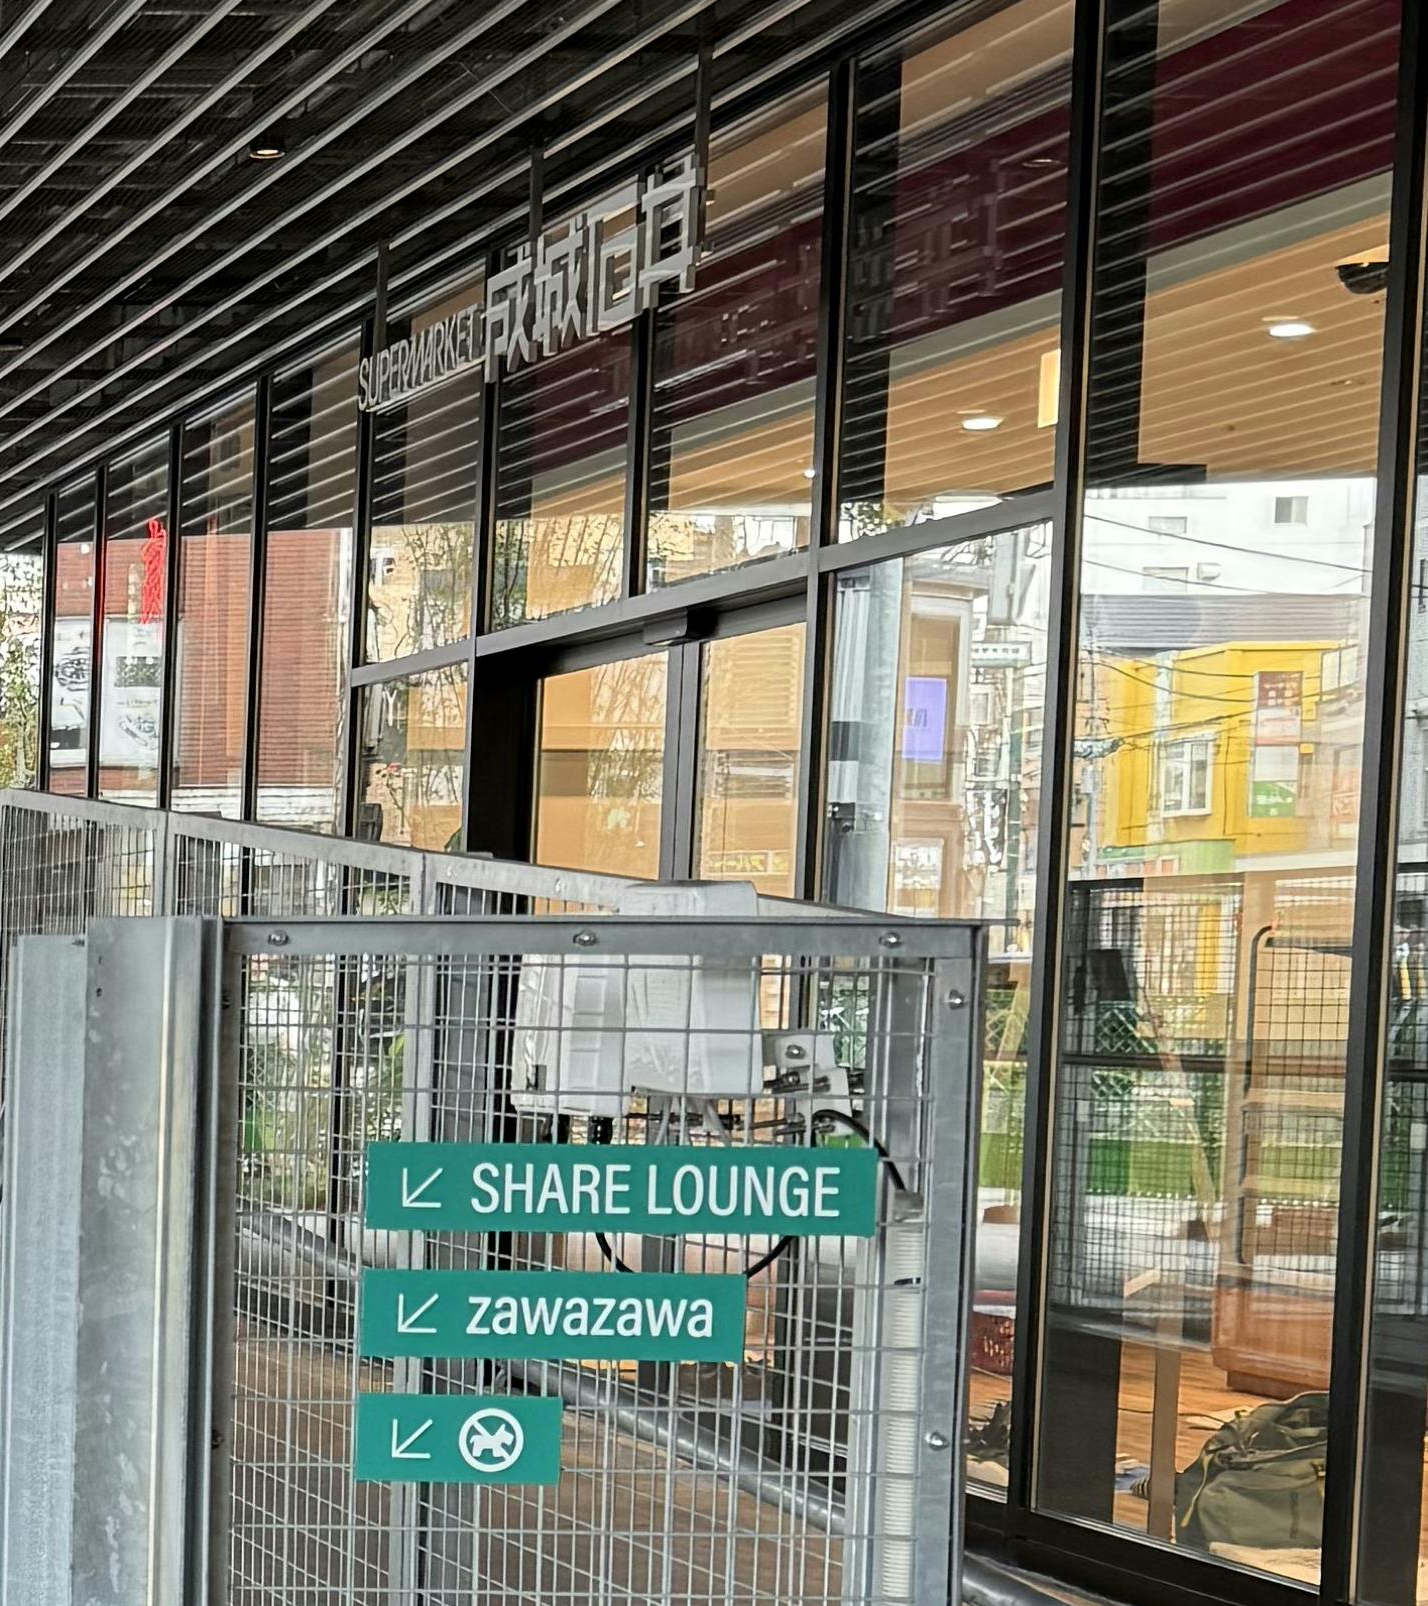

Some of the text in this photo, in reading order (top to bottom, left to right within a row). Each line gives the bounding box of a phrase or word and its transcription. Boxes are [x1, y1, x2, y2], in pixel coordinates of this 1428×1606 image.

[484, 150, 701, 384] 成城石井
[358, 303, 485, 411] SUPERMARKET
[471, 1162, 841, 1219] SHARE LOUNGE
[466, 1295, 713, 1338] zawazawa
